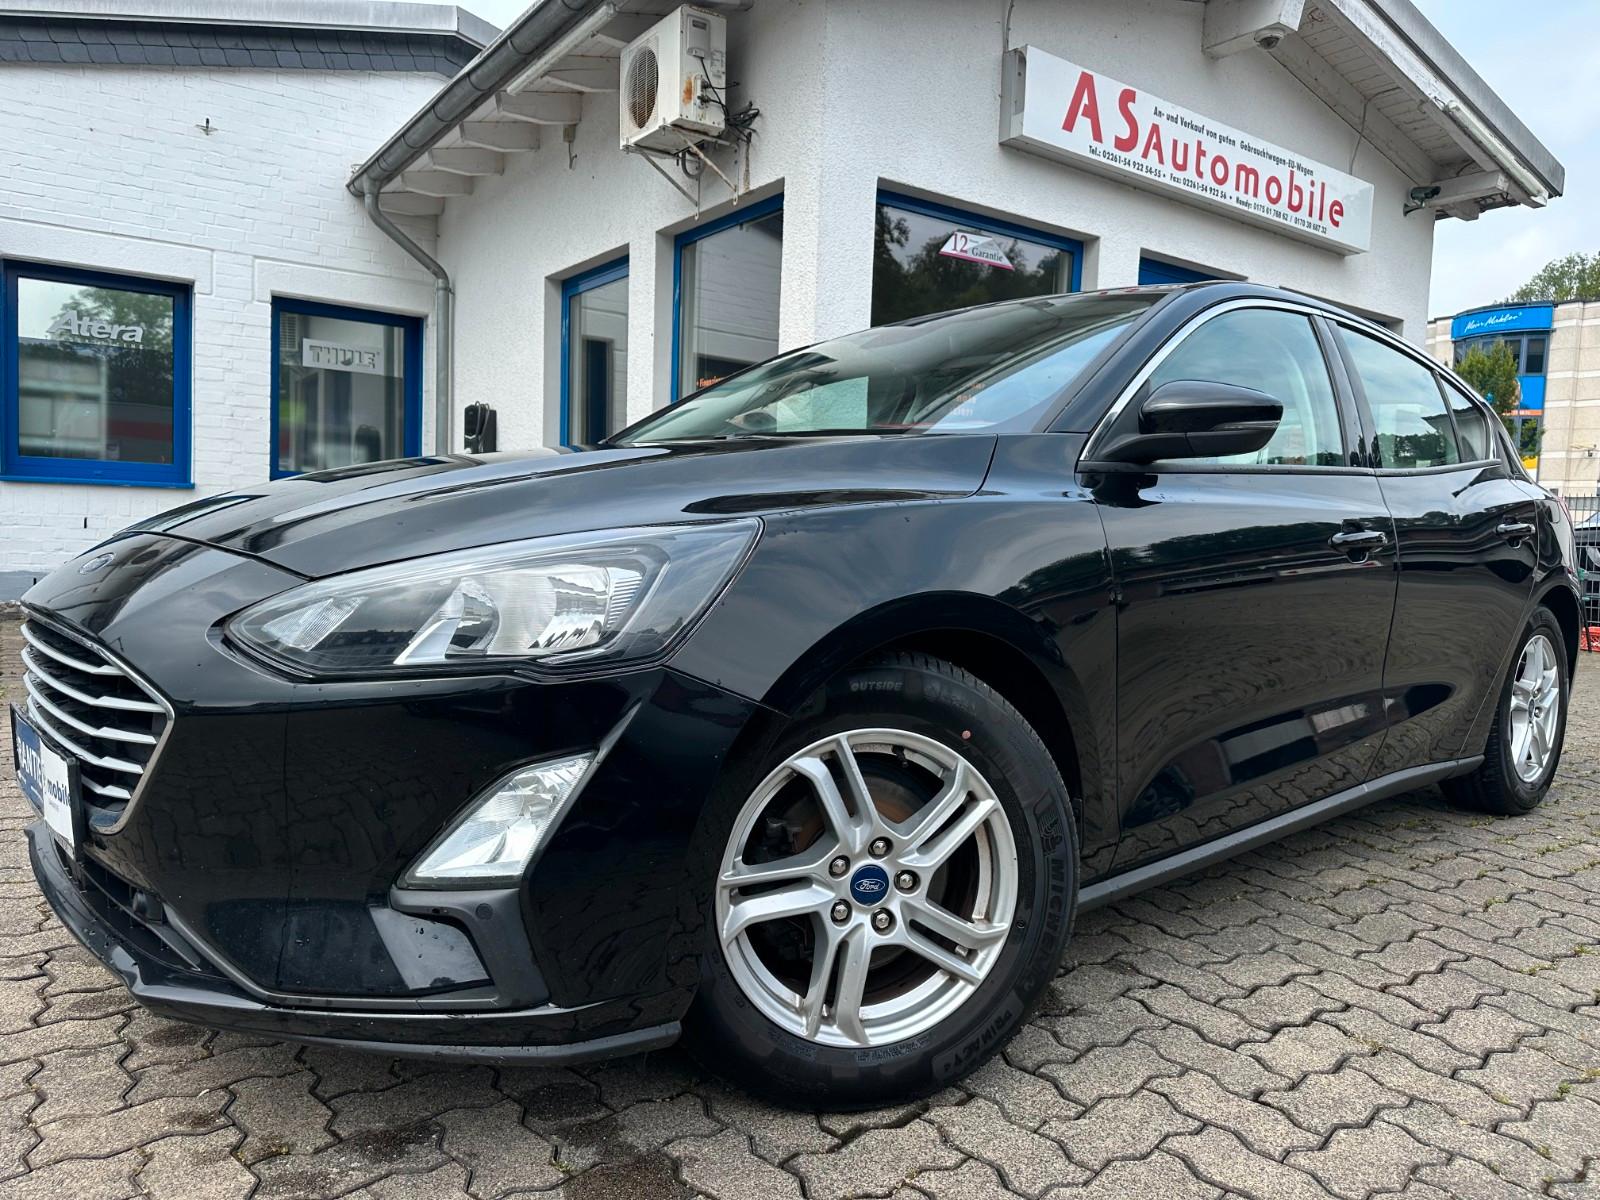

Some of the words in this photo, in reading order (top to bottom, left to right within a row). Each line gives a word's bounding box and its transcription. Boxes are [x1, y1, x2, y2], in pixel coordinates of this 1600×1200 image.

[1153, 106, 1165, 118] An-
[1166, 113, 1179, 125] und
[1180, 116, 1205, 135] Verkauf
[1206, 129, 1217, 139] von
[1218, 134, 1236, 147] guten
[1088, 144, 1101, 157] Tel.:
[1102, 149, 1131, 168] 02261-54
[1132, 160, 1143, 172] 922
[1182, 177, 1208, 193] 02261-54
[1209, 186, 1219, 197] 922
[952, 233, 968, 253] 12
[971, 247, 1004, 262] Garantie
[46, 310, 143, 342] Atera
[309, 345, 376, 369] THULE
[849, 680, 904, 692] OUTSIDE
[859, 880, 880, 890] Ford
